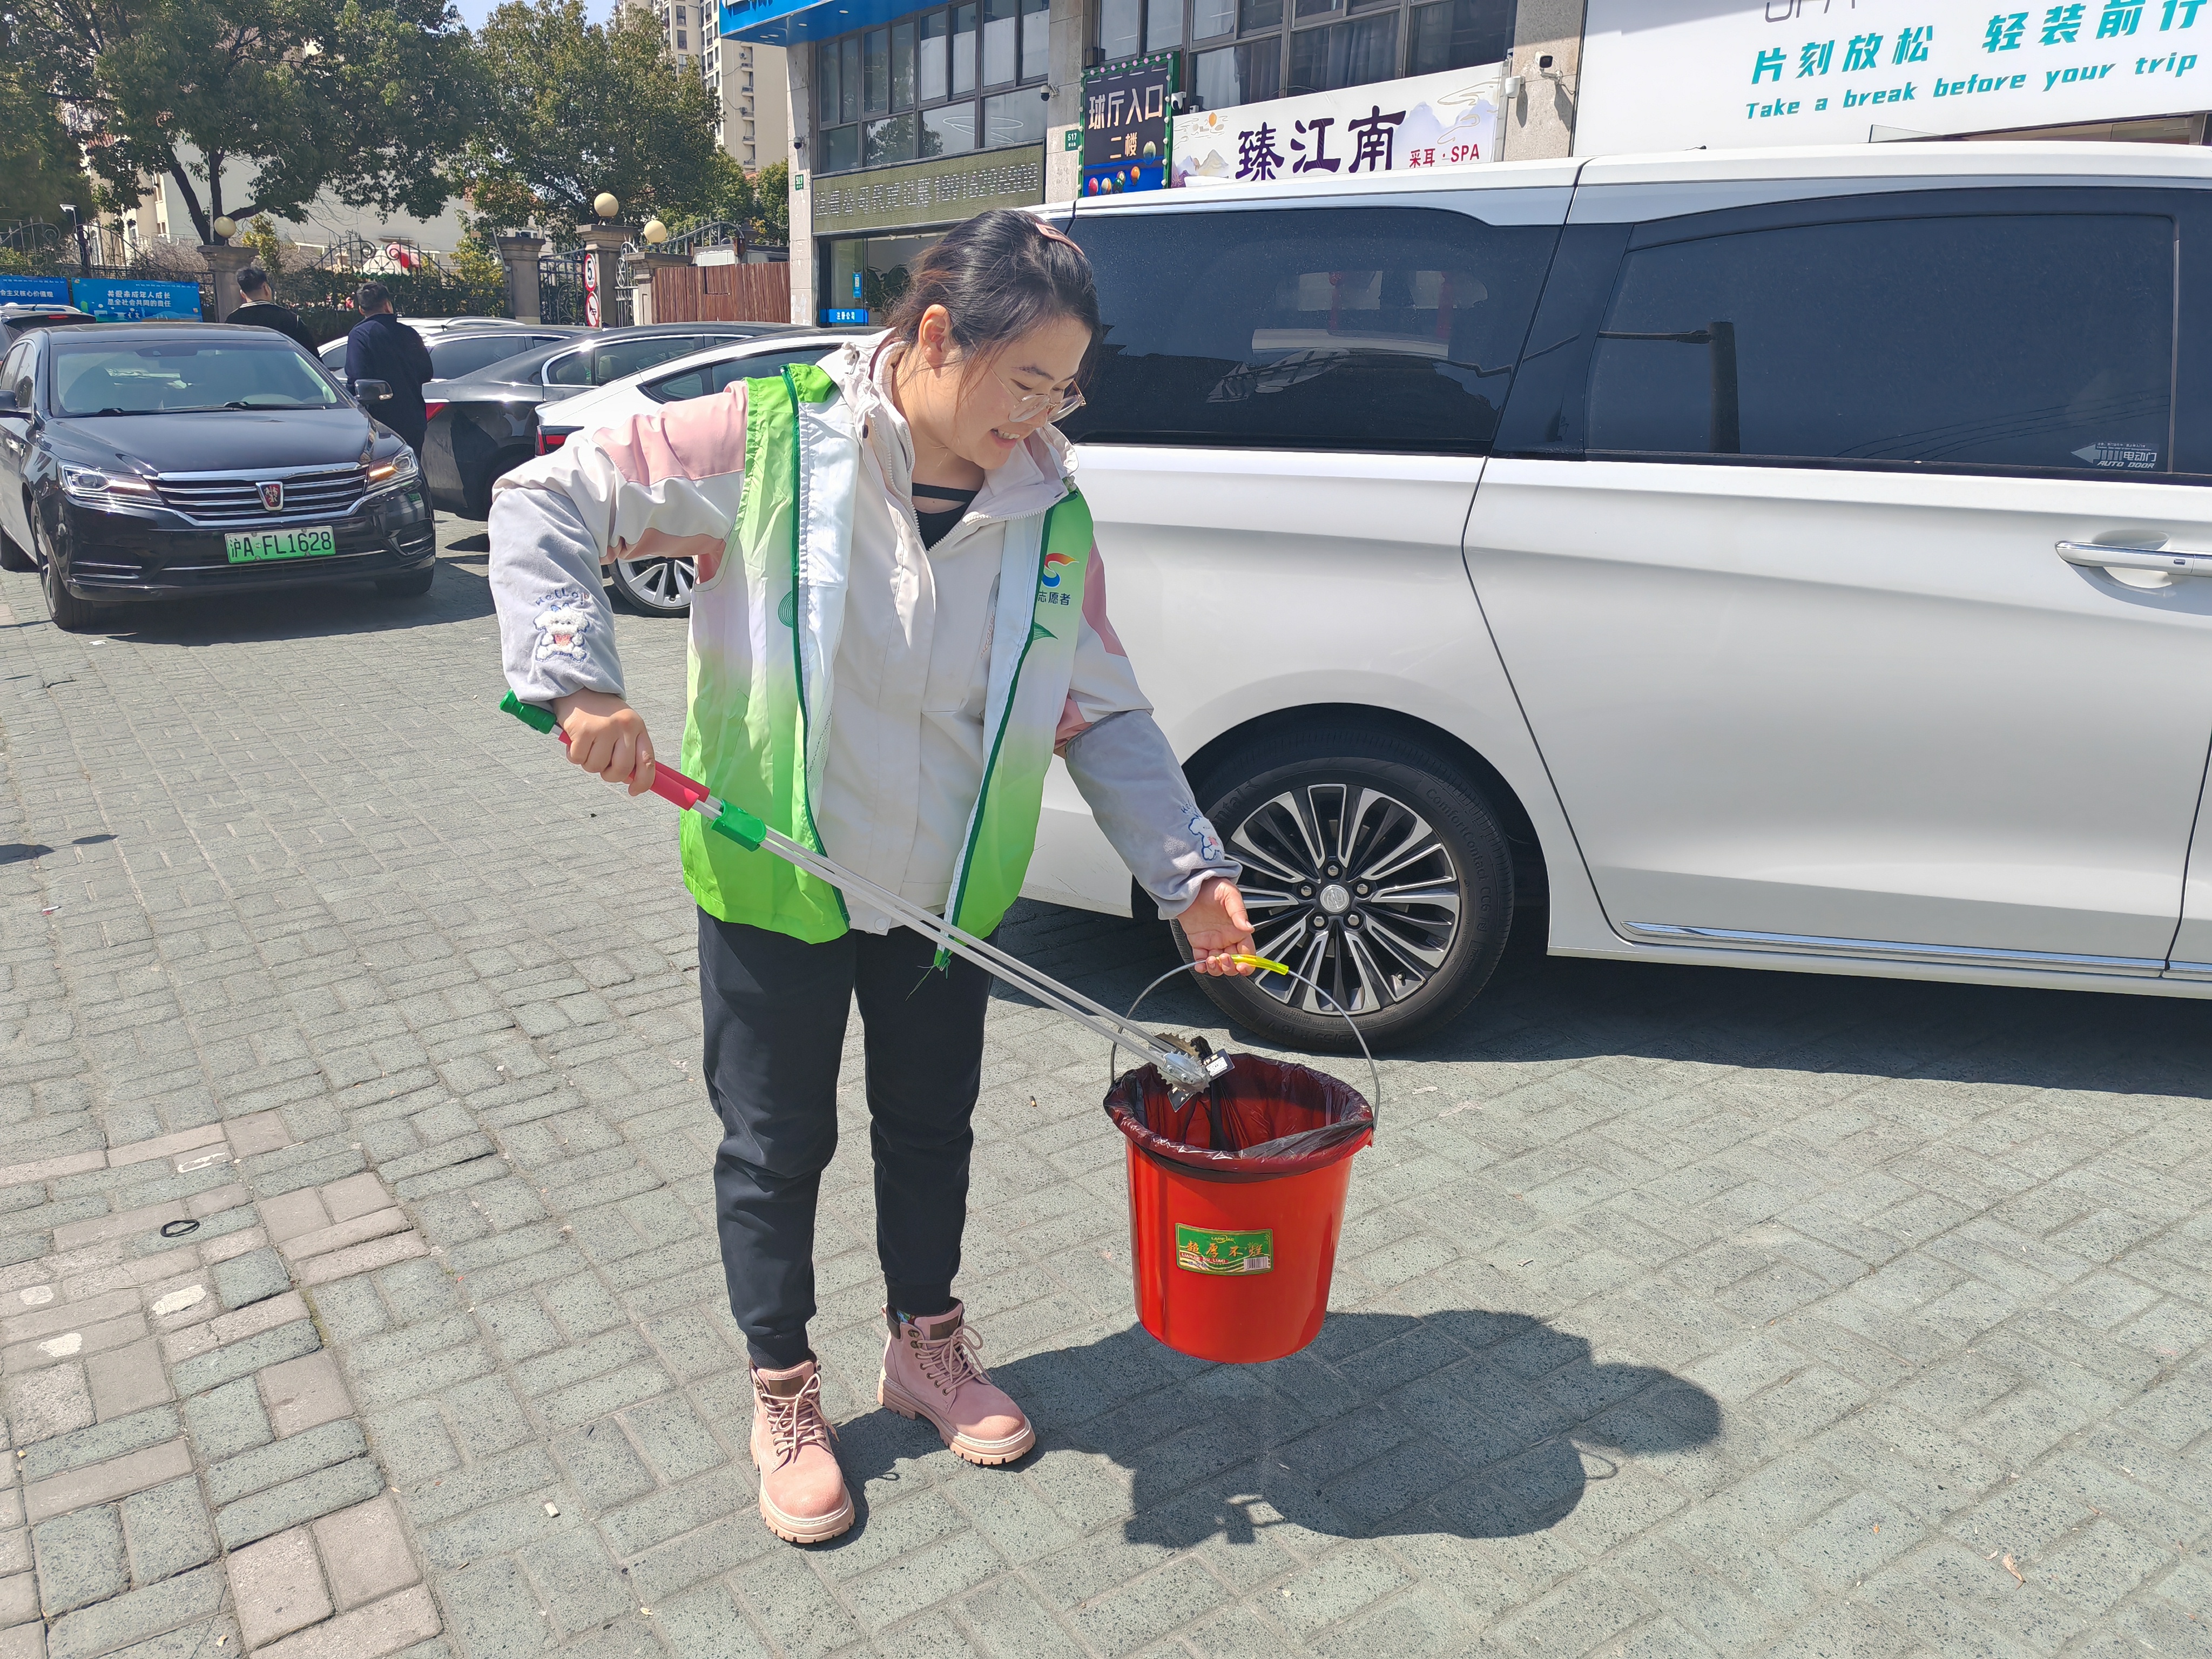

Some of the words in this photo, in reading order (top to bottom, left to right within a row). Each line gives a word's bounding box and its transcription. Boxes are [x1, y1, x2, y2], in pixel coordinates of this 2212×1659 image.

[1751, 25, 1933, 85] 片刻放松
[1745, 98, 1800, 119] Take
[1815, 97, 1829, 112] a
[1842, 81, 1918, 109] break
[1932, 73, 2027, 98] before
[2041, 63, 2117, 92] your
[2134, 52, 2197, 78] trip
[1088, 83, 1164, 130] 球厅入口
[1068, 132, 1077, 141] 517
[1109, 132, 1138, 159] 二楼
[1235, 105, 1406, 181] 臻江南
[587, 260, 592, 280] 5
[107, 299, 172, 307] 是全社会共同的责任
[2123, 451, 2157, 462] 电动门
[1038, 590, 1071, 606] 志愿者
